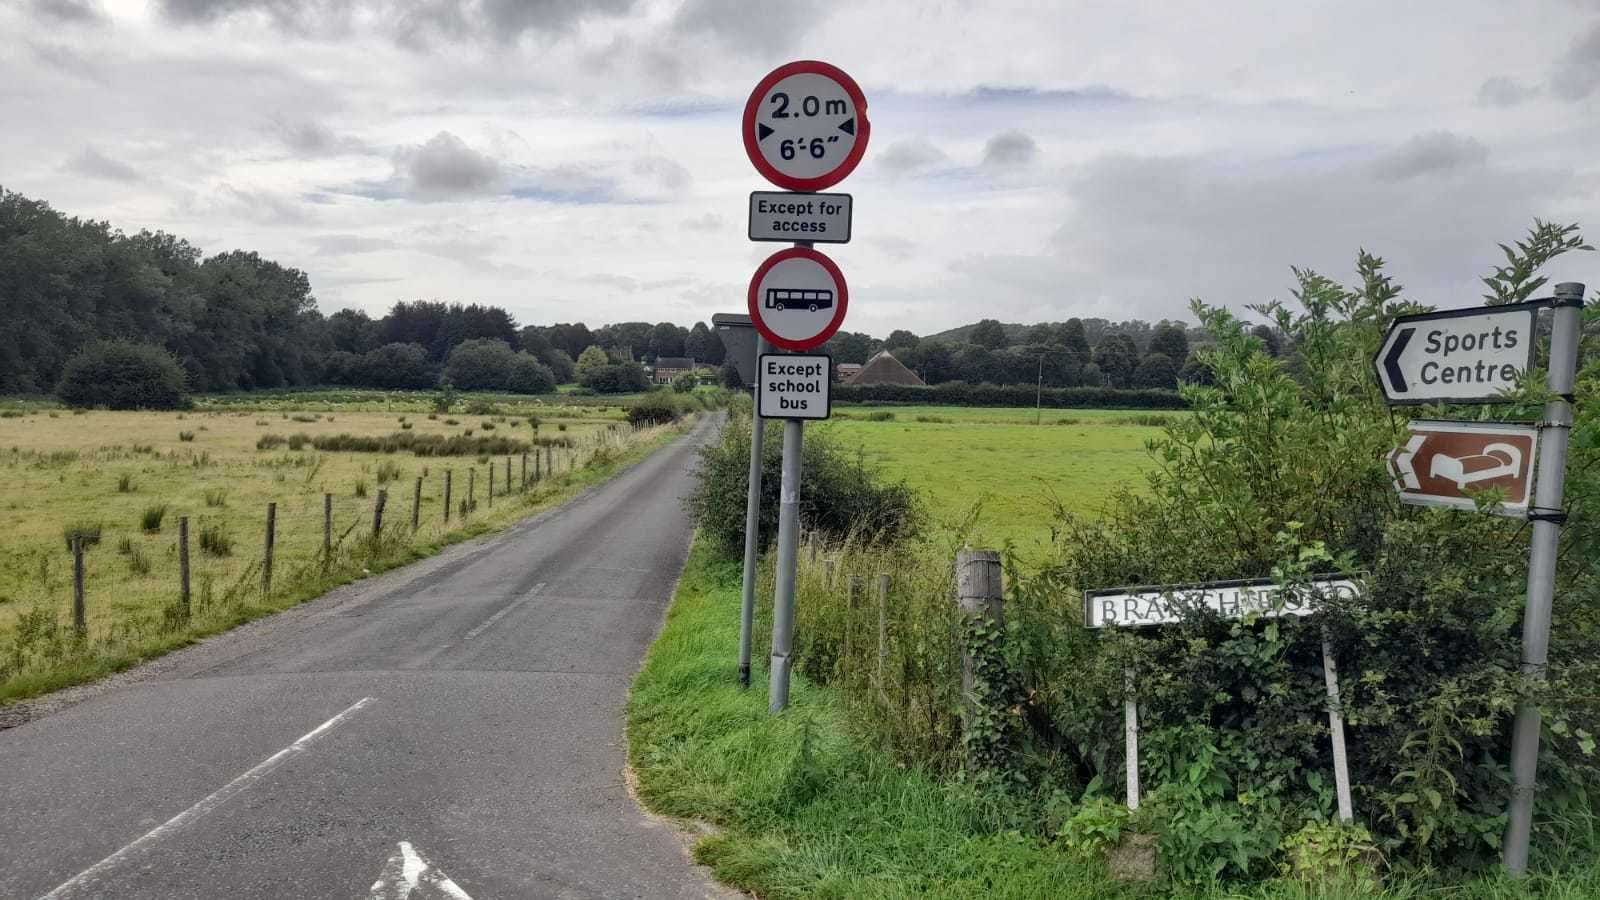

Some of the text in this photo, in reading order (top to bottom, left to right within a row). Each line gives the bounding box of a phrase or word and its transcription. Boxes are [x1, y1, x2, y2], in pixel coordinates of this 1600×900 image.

[758, 200, 842, 216] Except for
[772, 219, 826, 232] access
[1424, 326, 1518, 356] Sports
[767, 362, 822, 378] Except
[1420, 359, 1517, 385] Centre
[769, 379, 821, 393] school
[779, 396, 808, 410] bus
[1101, 591, 1241, 622] BRAH
